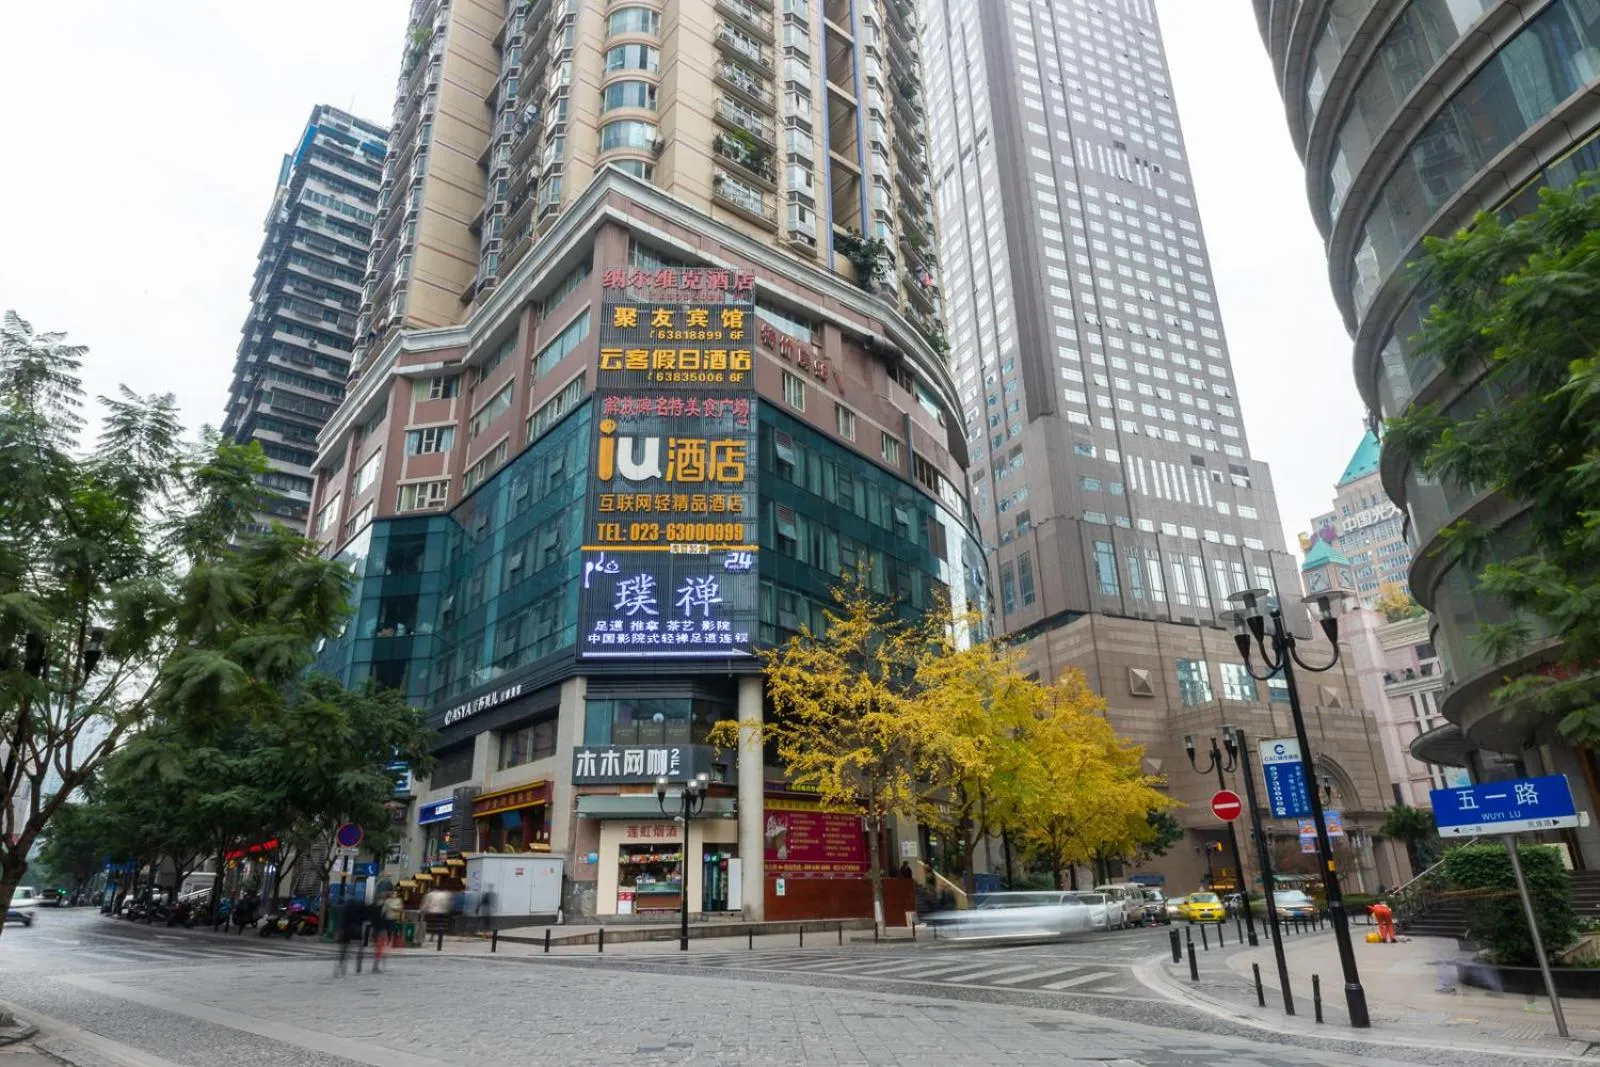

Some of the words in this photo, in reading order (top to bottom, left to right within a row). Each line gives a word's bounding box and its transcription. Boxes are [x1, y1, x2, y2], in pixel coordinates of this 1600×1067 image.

[602, 269, 755, 290] 纳尔维克酒店
[613, 306, 745, 329] 聚友宾馆
[657, 330, 722, 340] 63818899
[729, 330, 744, 340] 6F
[600, 348, 752, 370] 云客假日酒店
[656, 372, 724, 382] 63835006
[729, 372, 744, 382] 6F
[598, 494, 744, 512] 互联网轻精品酒店
[597, 523, 627, 541] TEL:
[629, 523, 744, 541] 023-63000999
[723, 552, 753, 570] 24
[613, 573, 723, 617] 璞禅
[594, 620, 623, 632] 足道
[630, 620, 660, 632] 推拿
[666, 620, 694, 632] 茶艺
[701, 620, 731, 632] 影院
[575, 749, 668, 777] 木木网咖
[1456, 782, 1539, 810] 五一路
[1481, 812, 1505, 821] WUYI
[1509, 810, 1521, 819] LU
